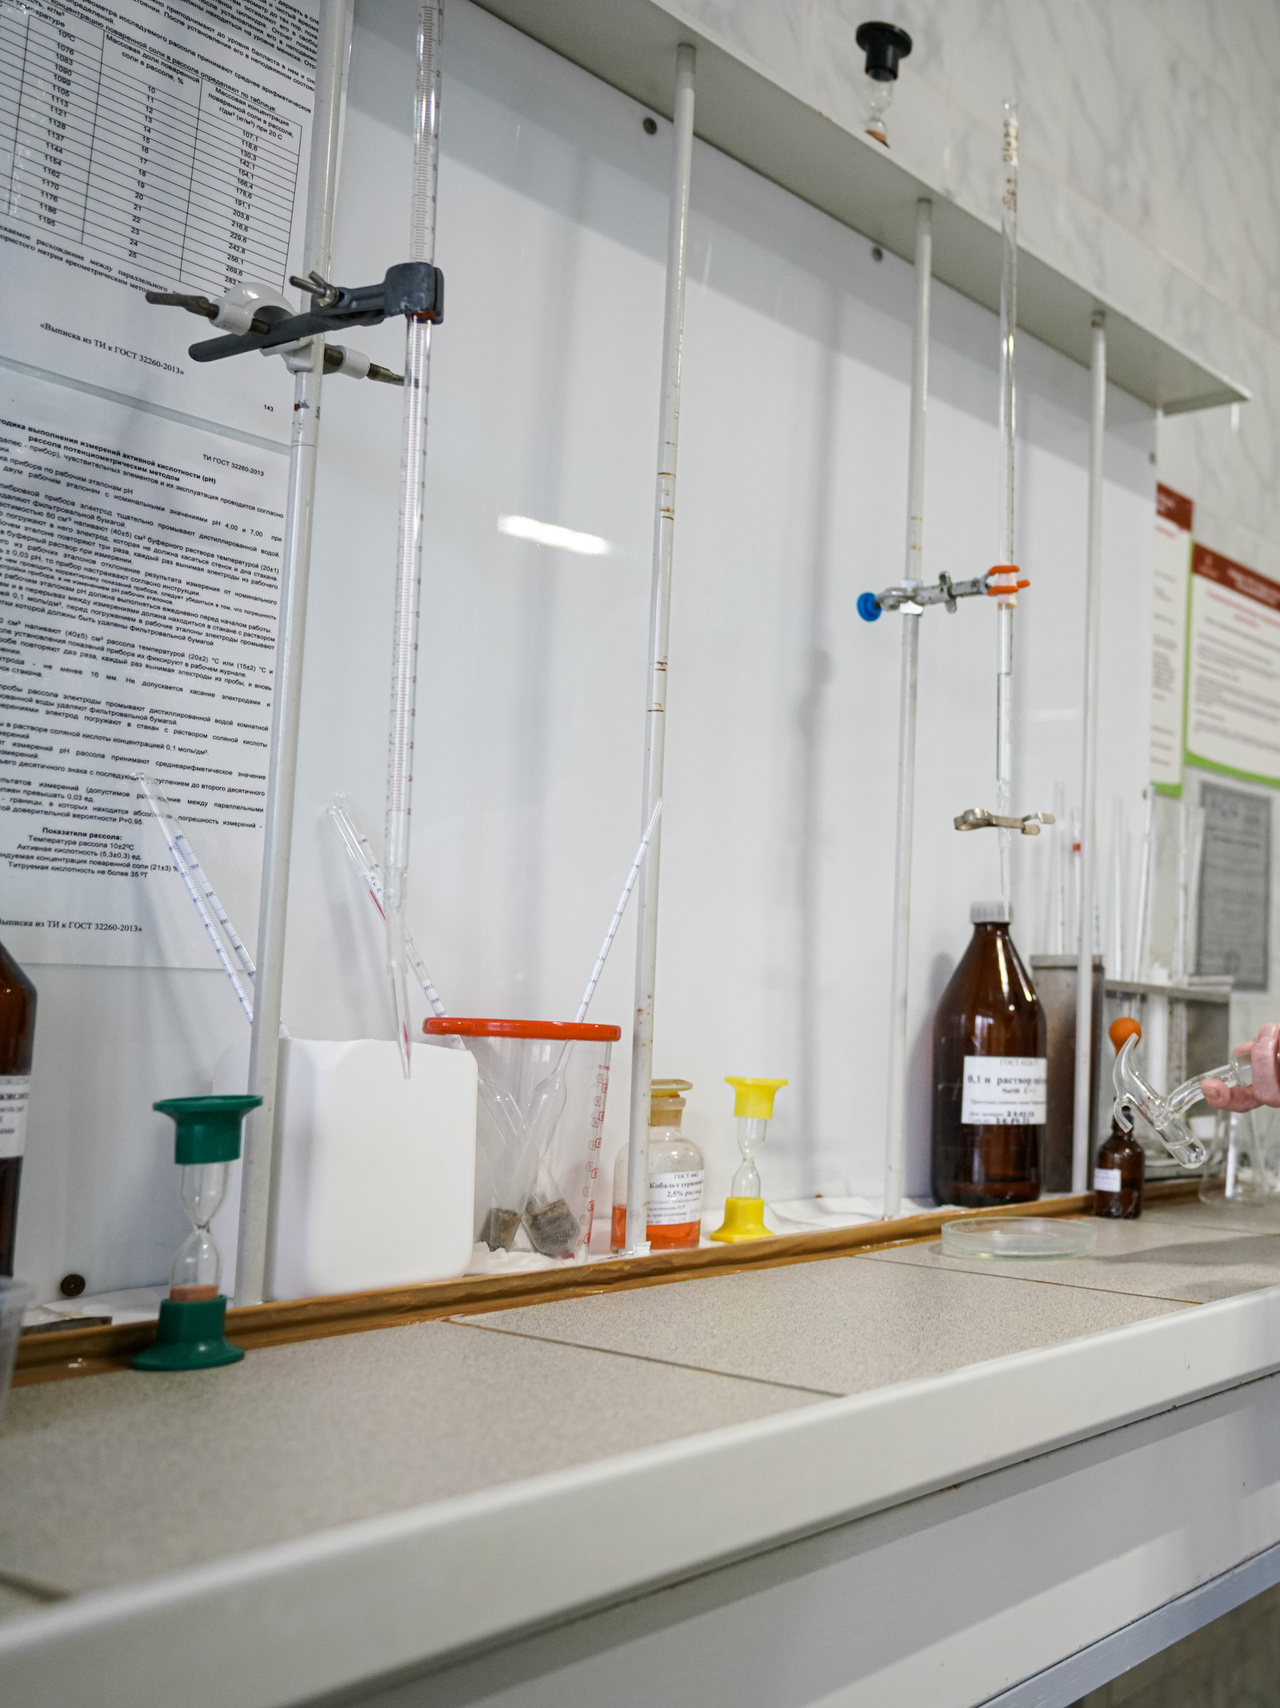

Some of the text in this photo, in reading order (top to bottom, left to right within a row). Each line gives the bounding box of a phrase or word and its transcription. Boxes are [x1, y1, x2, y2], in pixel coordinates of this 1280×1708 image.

[106, 34, 200, 83] Массовая доля поваренной
[121, 51, 138, 62] соли
[145, 63, 175, 81] рассоле,
[52, 95, 68, 107] 1113
[57, 43, 258, 142] 1076 10 107,1
[200, 72, 239, 94] определяют
[241, 91, 248, 99] по
[214, 86, 289, 126] Массовая концентрация
[51, 106, 67, 117] 1121
[142, 146, 148, 154] 16
[53, 85, 254, 179] 1105 14 154,1
[54, 74, 71, 86] 1099
[240, 159, 255, 170] 142,1
[55, 64, 256, 161] 1090 12 130,3
[208, 93, 246, 114] поваренной
[246, 111, 262, 122] соли
[267, 121, 293, 138] рассоле,
[256, 124, 267, 133] при
[268, 129, 276, 137] 20
[46, 142, 62, 153] 1144
[49, 118, 66, 129] 1128
[235, 199, 250, 209] 191,1
[48, 130, 249, 220] 1137 18 203,8
[42, 179, 59, 190] 1170
[132, 215, 140, 223] 22
[44, 167, 60, 178] 1162
[229, 243, 245, 254] 242,8
[135, 192, 143, 200] 20
[230, 232, 247, 243] 229,6
[38, 215, 137, 258] 1195 25
[131, 227, 139, 235] 23
[226, 265, 242, 276] 269,6
[93, 339, 106, 349] ТИ
[114, 346, 138, 359] ГОСТ
[263, 404, 274, 412] 143
[27, 426, 78, 444] выполнения
[79, 441, 120, 456] измерений
[122, 453, 155, 466] активной
[156, 463, 200, 479] кислотности
[28, 435, 180, 481] рассола потенциометрическим методом
[202, 453, 264, 476] ТИ ГОСТ 32260-2013
[2, 466, 23, 474] двум
[27, 472, 61, 484] рабочим
[65, 482, 100, 494] эталонам
[113, 495, 165, 511] номинальными
[169, 508, 208, 522] значениями
[224, 522, 238, 531] 4,00
[250, 528, 263, 537] 7,00
[44, 494, 75, 506] прибора
[79, 503, 112, 516] электрод
[116, 512, 154, 526] тщательно
[157, 523, 195, 536] промывают
[198, 534, 257, 551] дистиллированной
[26, 545, 58, 555] рабочих
[62, 553, 96, 564] эталонов
[100, 561, 140, 574] отклонение
[144, 571, 182, 584] результата
[185, 581, 220, 592] измерения
[234, 592, 277, 605] номинального
[4, 573, 37, 584] рабочим
[39, 580, 74, 592] эталонам
[87, 591, 115, 600] должна
[116, 596, 160, 610] выполняться
[199, 614, 219, 623] перед
[220, 619, 247, 628] началом
[16, 843, 52, 852] Активная
[53, 848, 98, 856] кислотность
[28, 834, 77, 845] Температура
[78, 840, 107, 848] рассола
[41, 826, 122, 840] Показатели рассола:
[8, 861, 49, 870] Титруемая
[50, 866, 95, 874] кислотность
[35, 855, 87, 864] концентрация
[88, 859, 130, 867] поваренной
[47, 920, 59, 928] ТИ
[68, 921, 92, 929] ГОСТ
[968, 1075, 980, 1084] 0,1
[997, 1077, 1031, 1086] раствор
